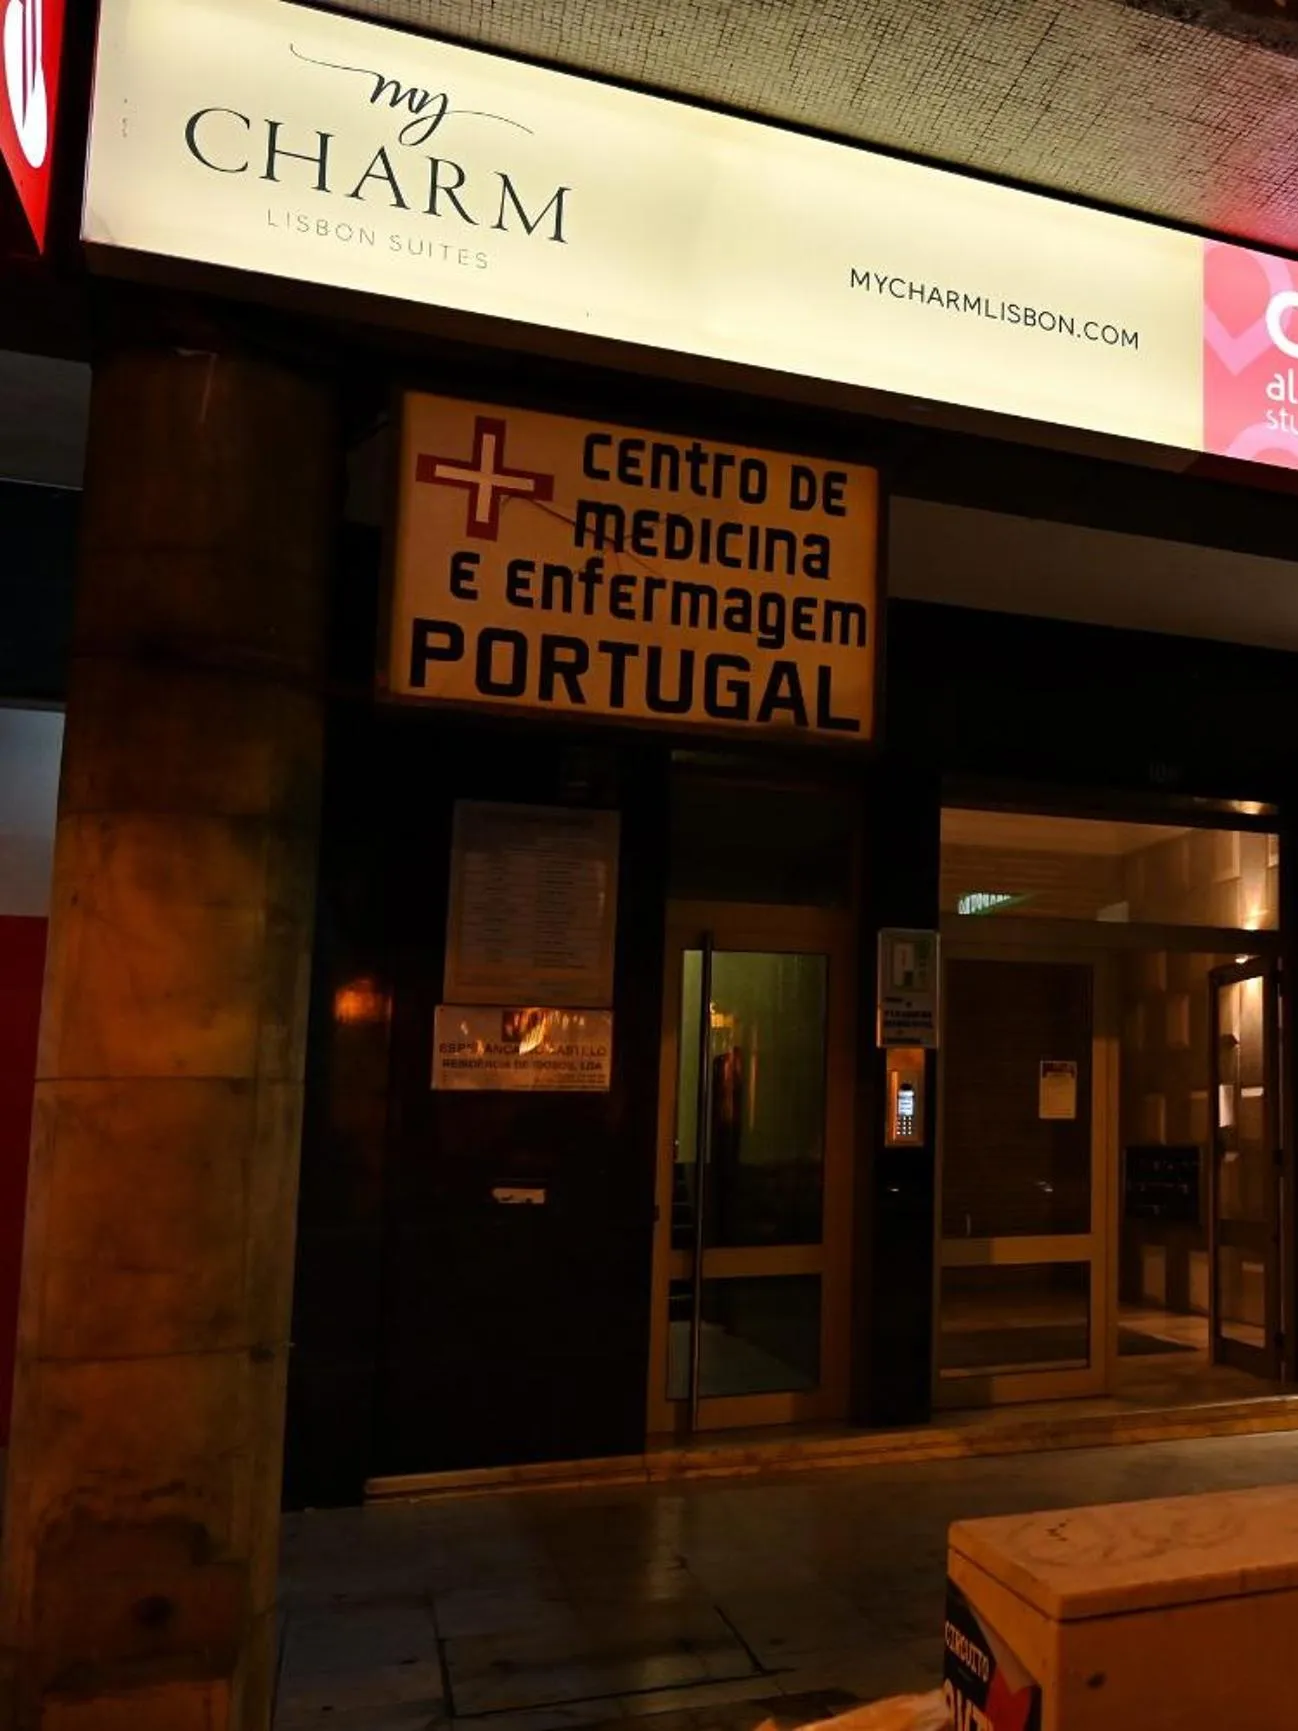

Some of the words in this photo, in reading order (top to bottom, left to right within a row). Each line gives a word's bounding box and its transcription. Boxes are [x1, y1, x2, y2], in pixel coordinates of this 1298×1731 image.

[184, 107, 572, 244] CHARM
[266, 208, 377, 246] LISBON
[388, 234, 489, 270] SUITES
[849, 267, 1140, 350] MYCHARMLISBON.COM
[789, 464, 848, 517] DE
[449, 551, 481, 600] E
[408, 617, 861, 733] PORTUGAL
[944, 1619, 991, 1683] CIRCUITO
